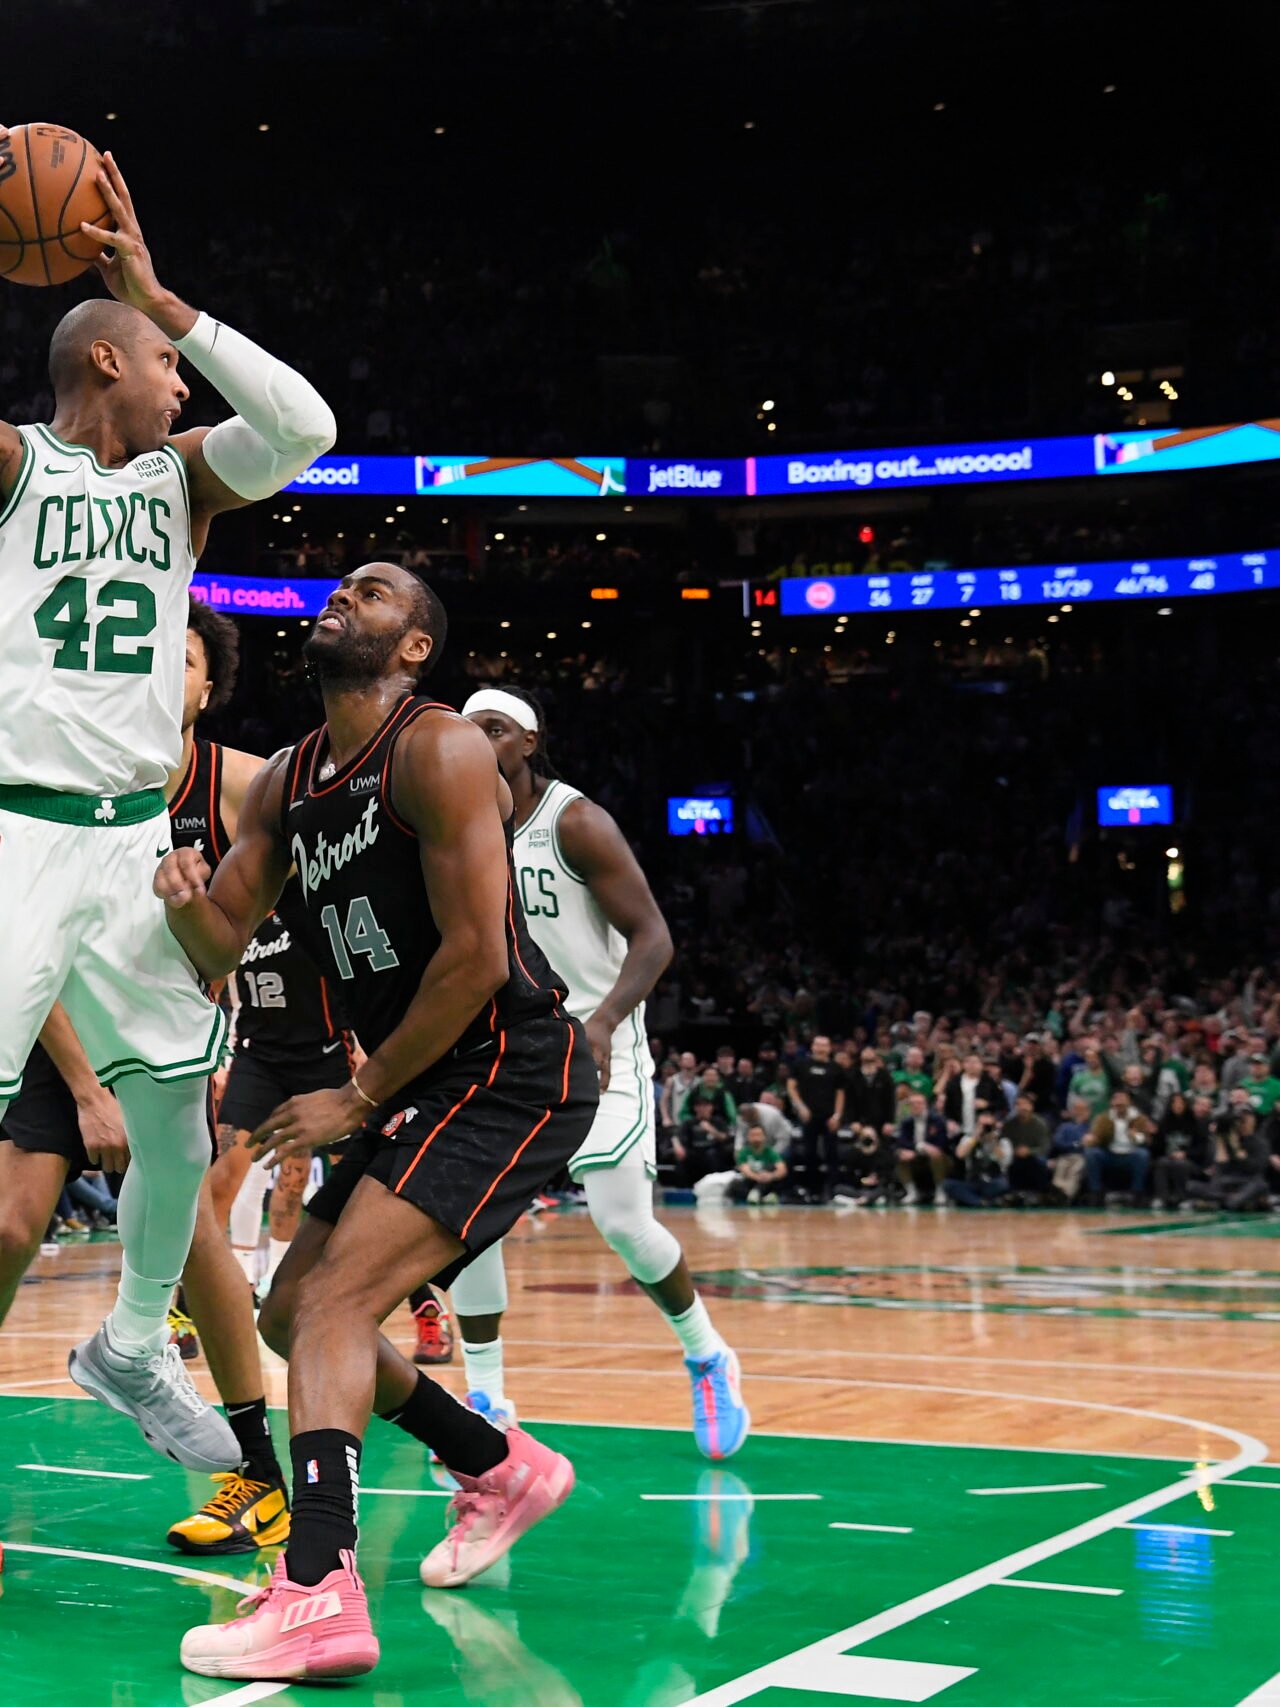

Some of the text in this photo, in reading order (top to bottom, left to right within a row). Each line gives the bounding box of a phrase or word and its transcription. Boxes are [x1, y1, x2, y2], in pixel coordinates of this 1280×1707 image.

[133, 456, 166, 471] VISTA
[139, 465, 170, 479] PRINT
[788, 446, 1032, 485] Boxing out...woooo!
[648, 464, 721, 492] jetBlue
[33, 492, 171, 571] CELTICS
[211, 582, 230, 604] in
[233, 587, 305, 608] coach.
[754, 590, 776, 606] 14
[869, 589, 892, 607] 56
[911, 587, 934, 605] 27
[961, 585, 974, 602] 7
[1252, 567, 1263, 585] 1
[33, 575, 157, 674] 42
[350, 774, 380, 792] UWM
[175, 817, 206, 830] UWM
[528, 829, 549, 840] VISTA
[528, 840, 550, 848] PRINT
[240, 930, 291, 965] etroit
[321, 896, 400, 980] 14
[244, 971, 286, 1008] 12
